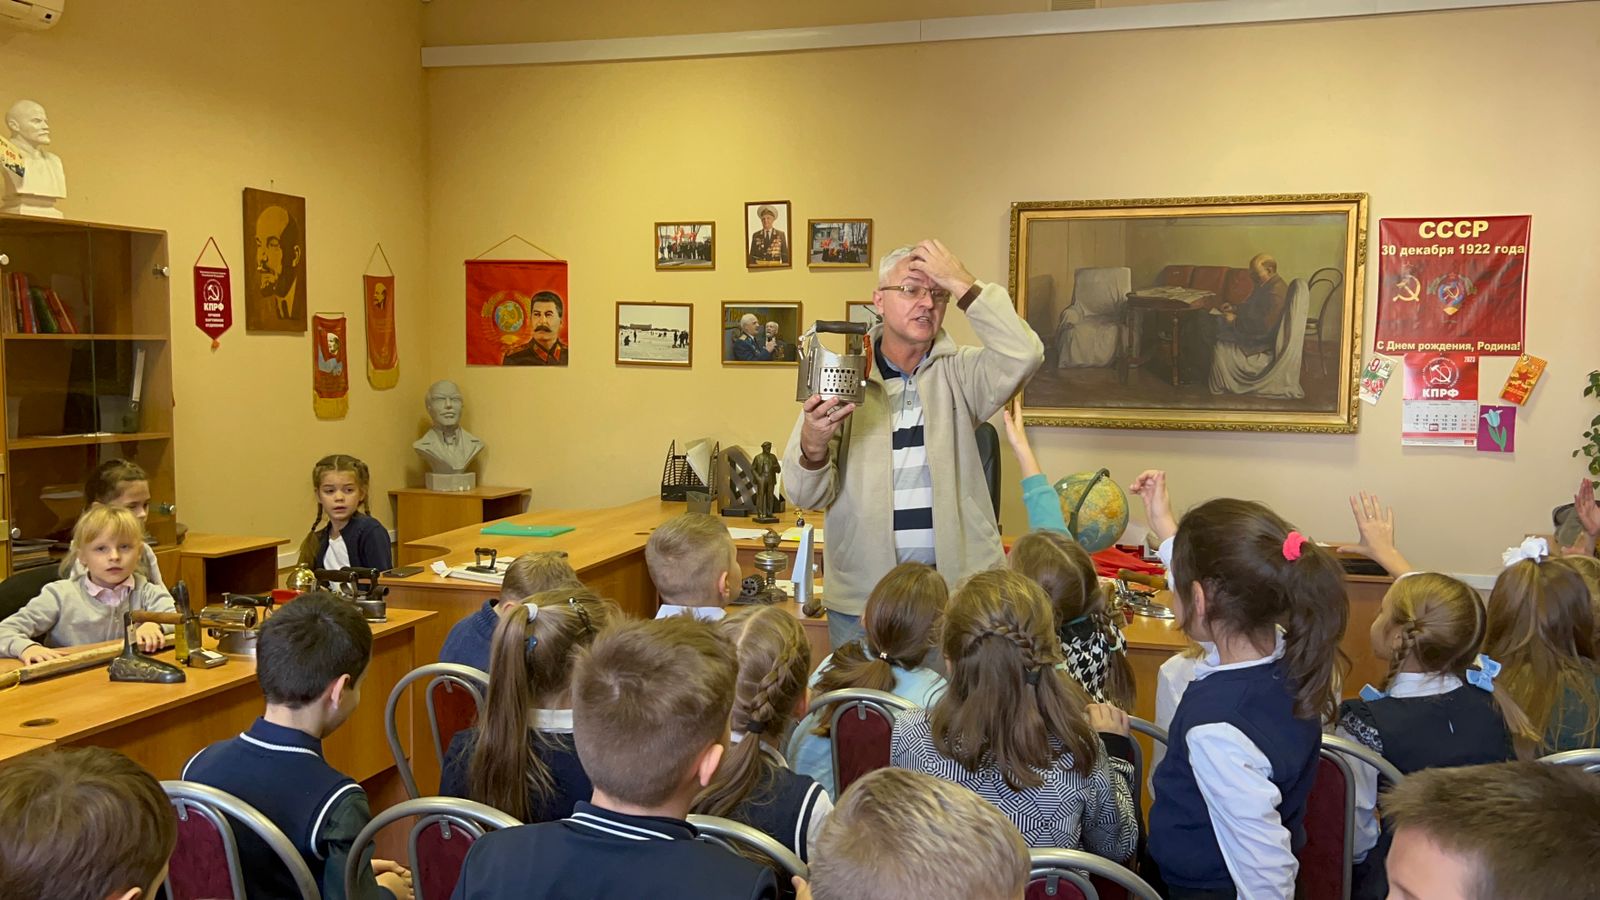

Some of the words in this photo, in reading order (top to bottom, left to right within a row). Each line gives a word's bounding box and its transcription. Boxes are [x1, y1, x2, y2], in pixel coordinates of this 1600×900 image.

[1419, 220, 1489, 239] СССР
[1381, 245, 1396, 256] 30
[1400, 244, 1454, 257] декабря
[1459, 244, 1490, 255] 1922
[1494, 244, 1525, 255] года
[203, 302, 225, 312] КПРФ
[1376, 341, 1384, 350] С
[1386, 341, 1416, 351] Днем
[1419, 341, 1475, 352] рождения,
[1477, 341, 1521, 352] Родина!
[1422, 388, 1460, 398] КПРФ
